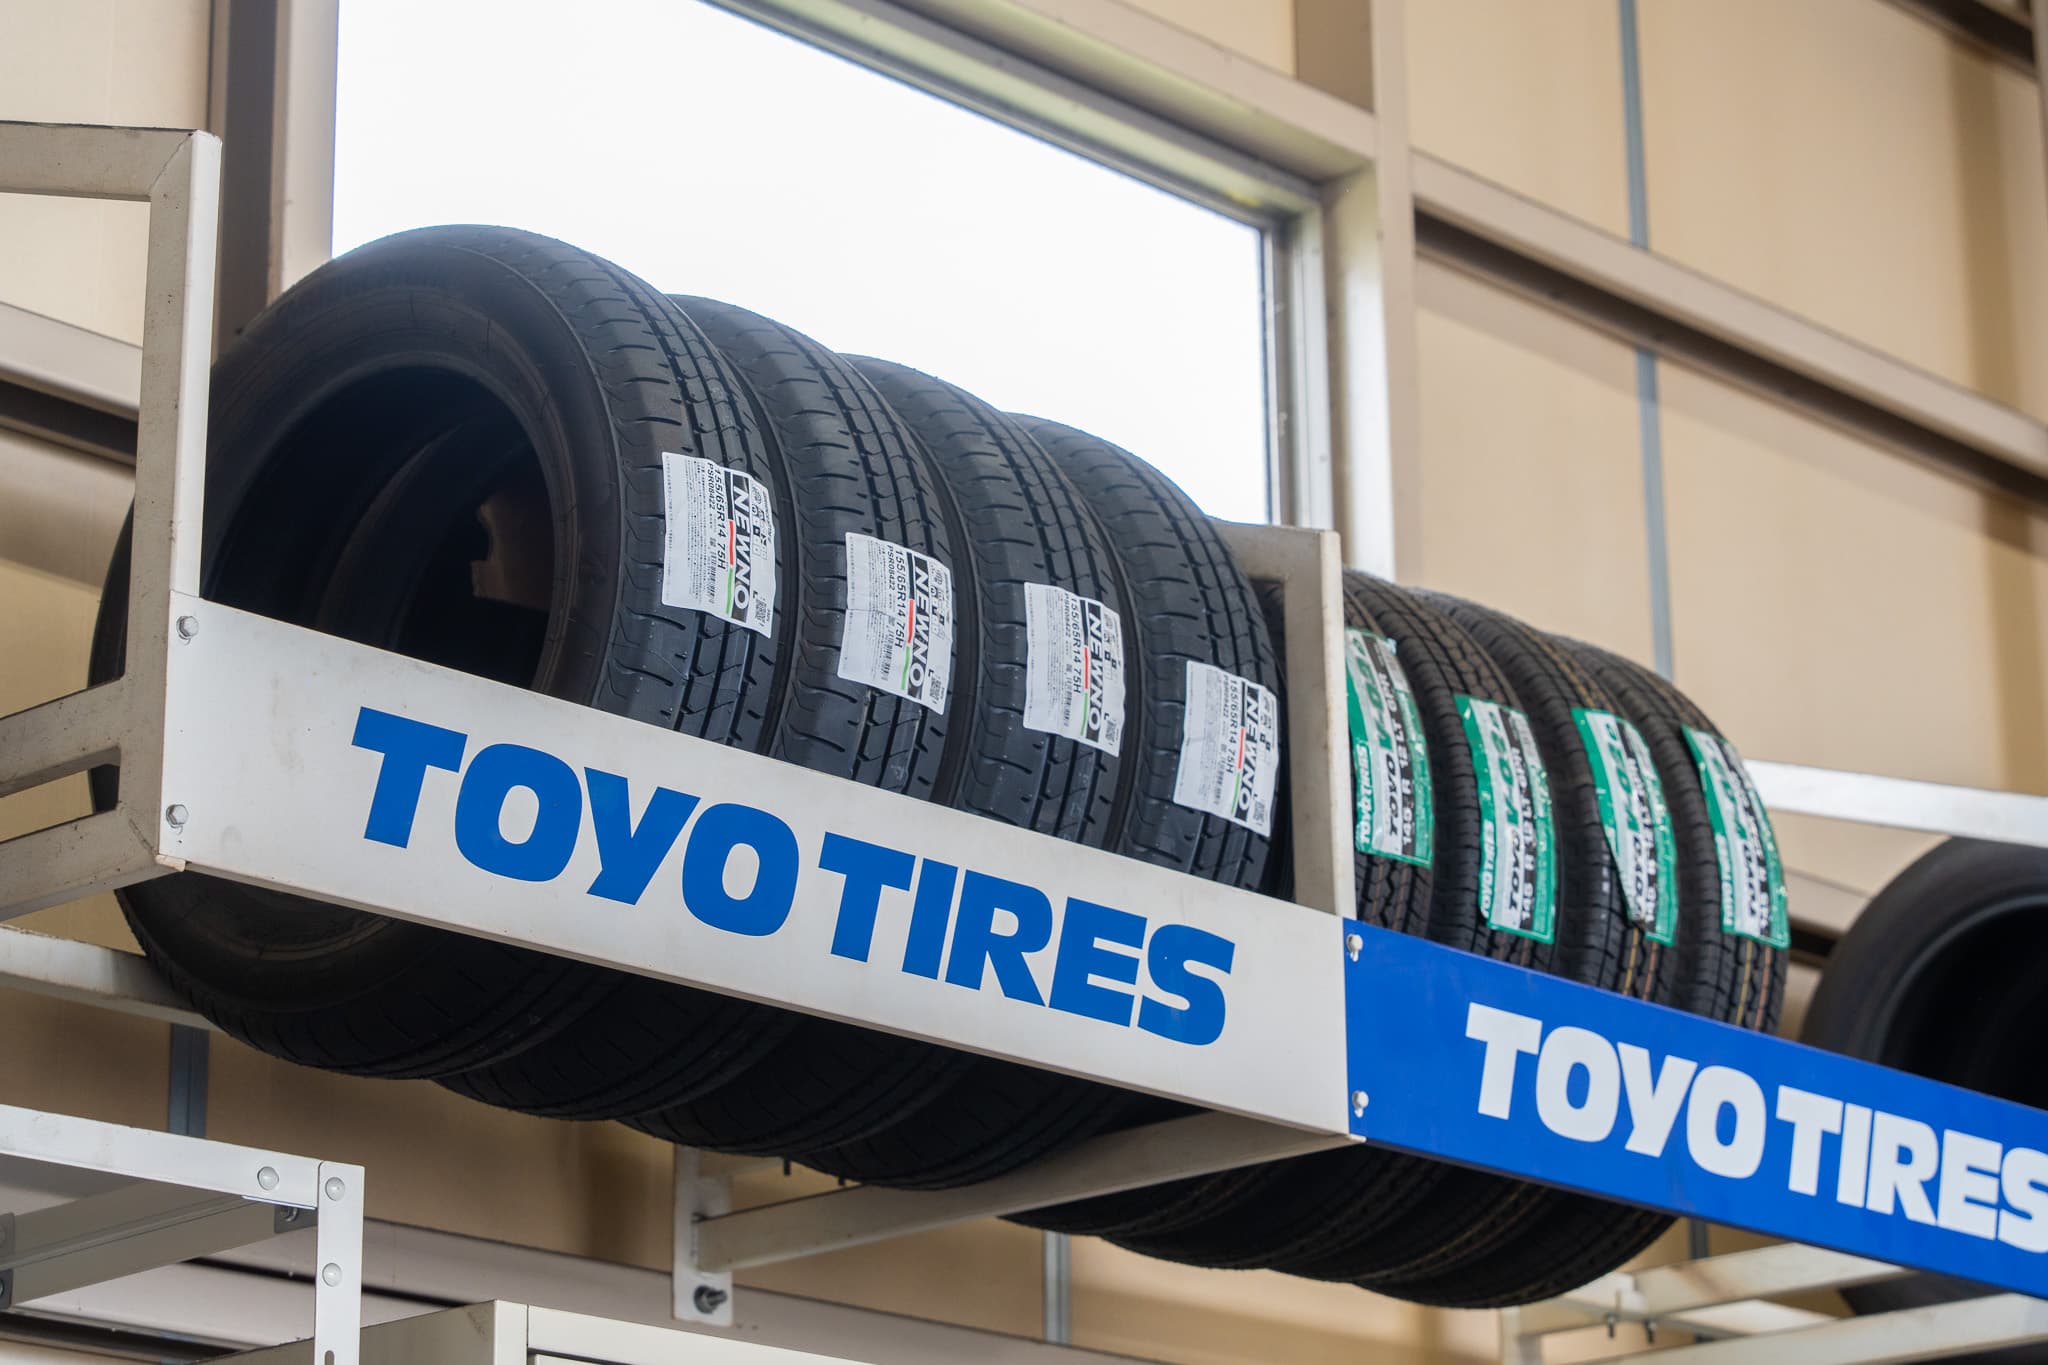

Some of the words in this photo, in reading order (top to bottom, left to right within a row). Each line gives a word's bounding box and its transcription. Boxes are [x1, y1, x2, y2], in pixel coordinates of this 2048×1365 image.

[714, 469, 726, 537] 155/65R14
[717, 542, 726, 569] 75H
[733, 485, 750, 609] NEWNO
[895, 549, 907, 617] 155/65R14
[894, 621, 905, 648] 75H
[909, 566, 929, 688] NEWNO
[1071, 597, 1082, 664] 155/65R14
[1073, 669, 1082, 694] 75H
[1088, 612, 1103, 731] NEWNO
[1229, 679, 1240, 744] 155/65R14
[1225, 749, 1236, 774] 75H
[1238, 696, 1259, 810] NEWNO
[1401, 779, 1412, 794] R
[1385, 753, 1399, 837] TOYO
[1402, 808, 1413, 846] 145
[351, 706, 800, 936] TOYO
[818, 831, 1236, 1046] TIRES
[1508, 828, 1520, 911] TOYO
[1465, 1002, 1767, 1180] TOYO
[1776, 1084, 2048, 1253] TIRES
